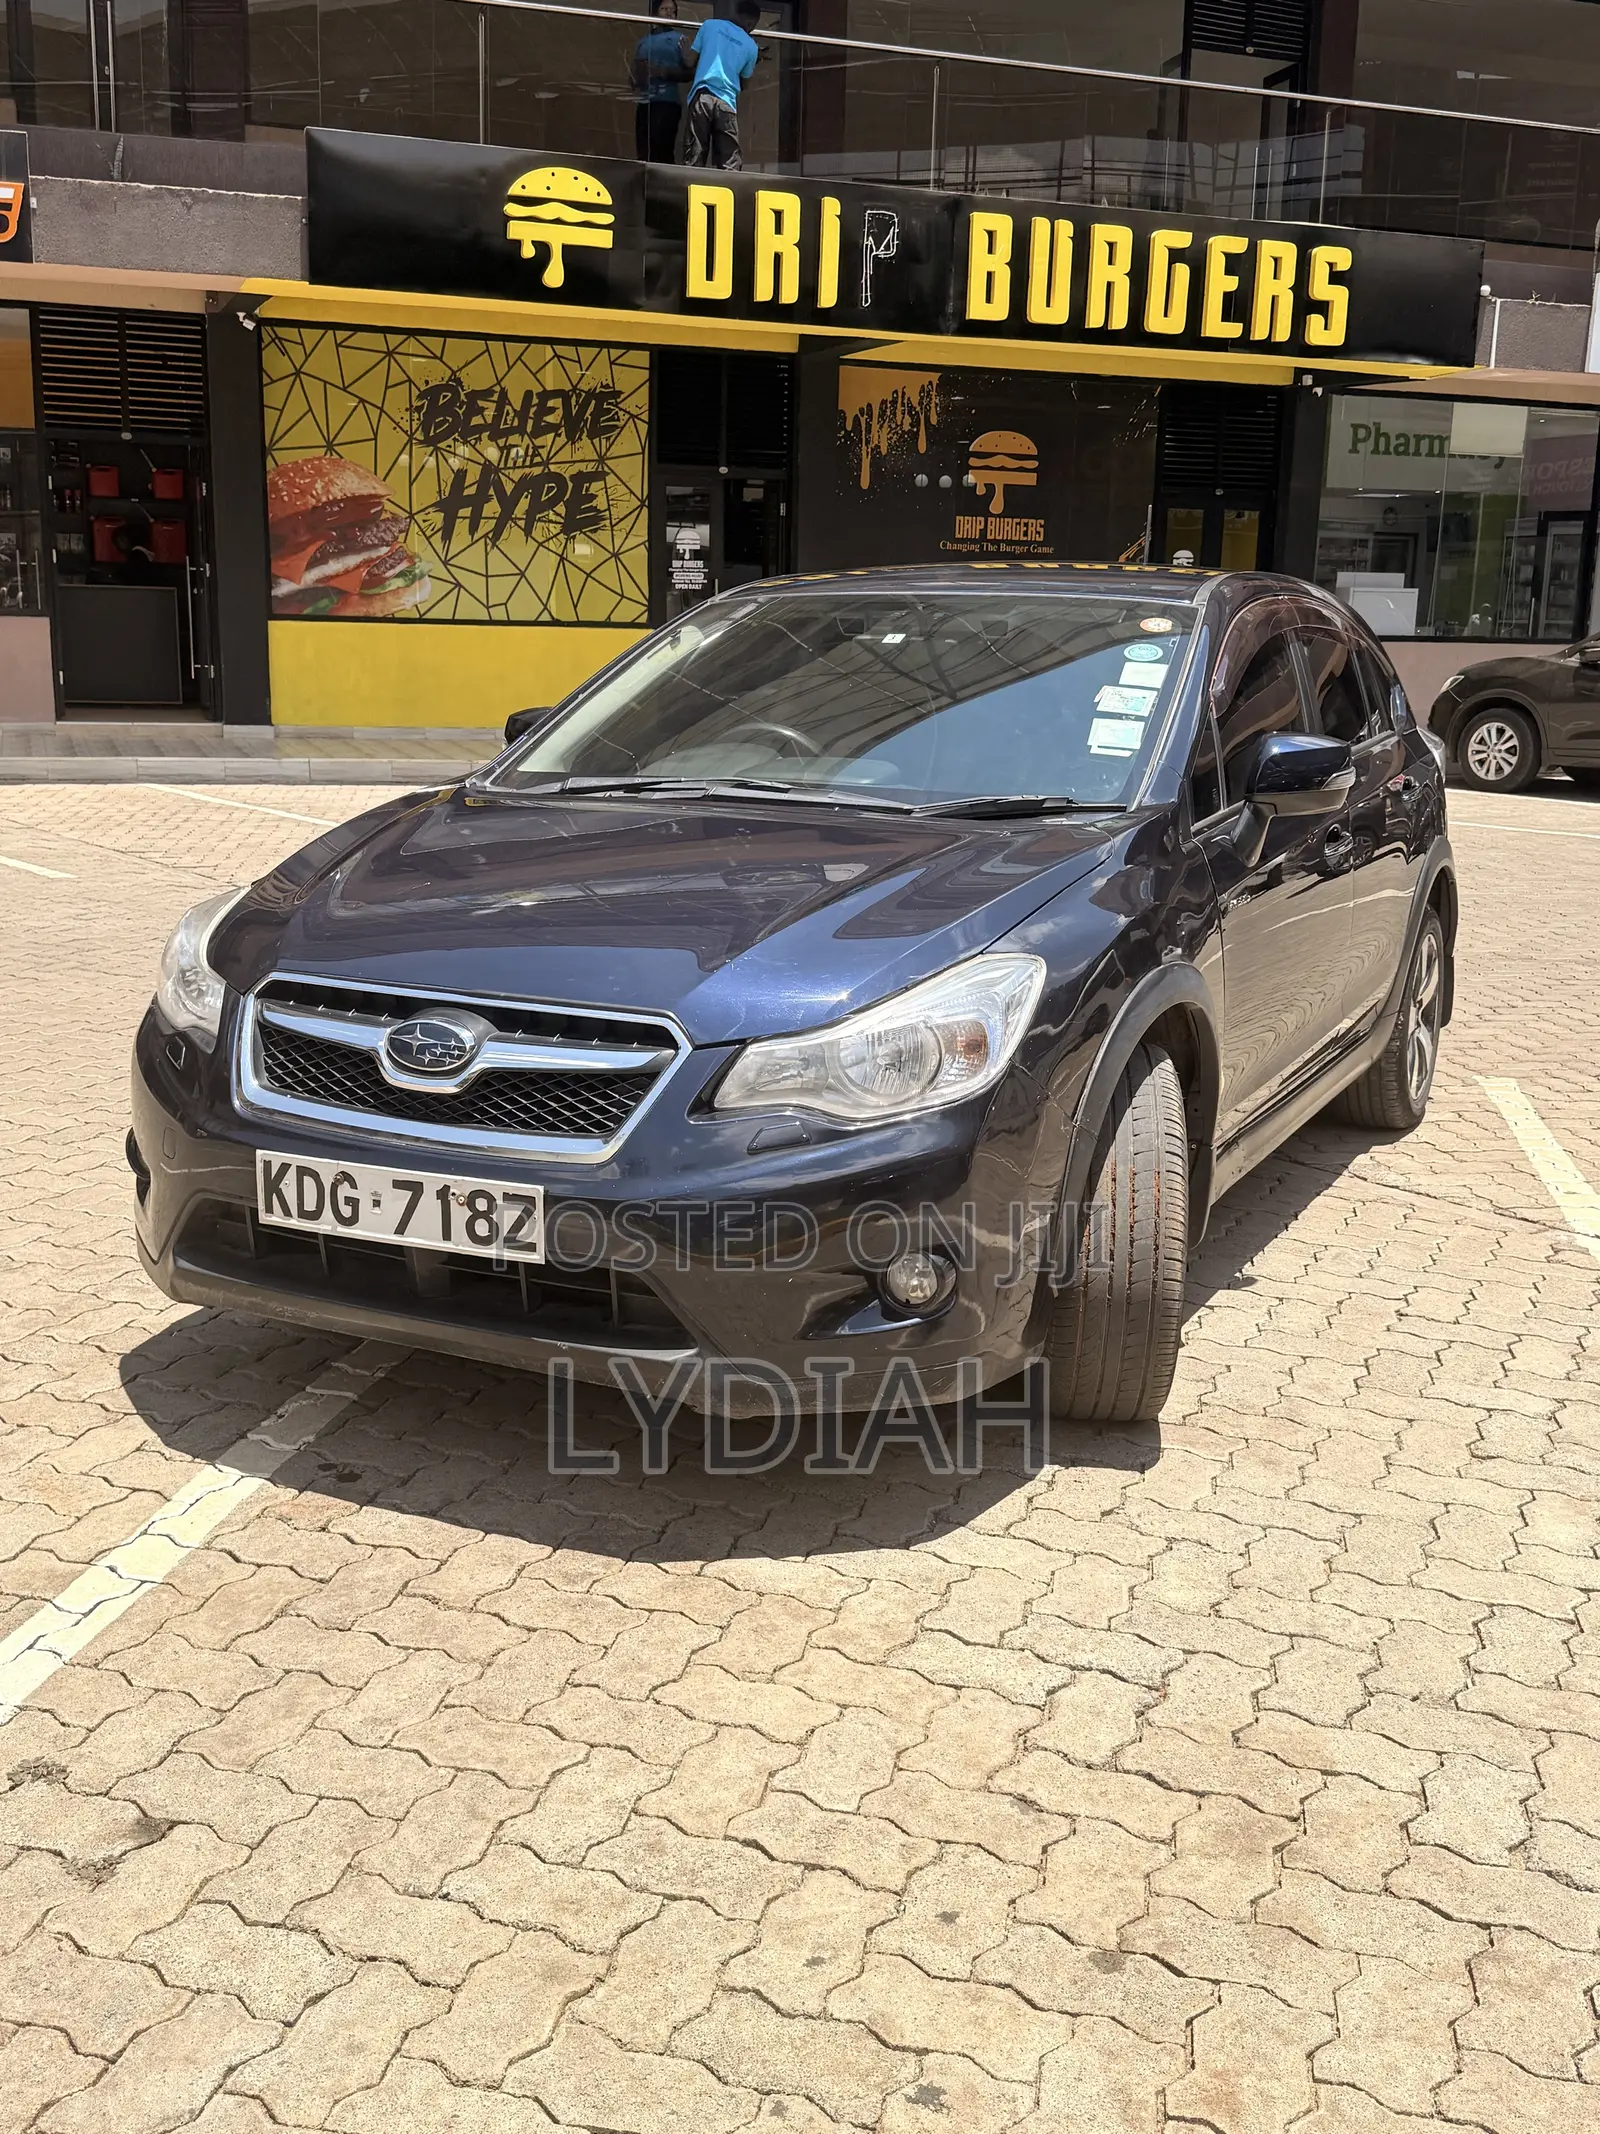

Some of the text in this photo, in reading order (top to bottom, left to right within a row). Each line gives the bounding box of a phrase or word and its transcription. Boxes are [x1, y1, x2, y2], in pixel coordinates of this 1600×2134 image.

[965, 211, 1353, 347] BURGERS
[415, 381, 625, 447] BELIEVE
[498, 443, 546, 472] THE
[1348, 421, 1506, 470] Pharm
[433, 462, 611, 546] HYPE
[954, 515, 1045, 542] DRIP BURGERS
[939, 539, 1055, 555] Changing The Burger Game
[263, 1159, 538, 1253] KDG 718Z
